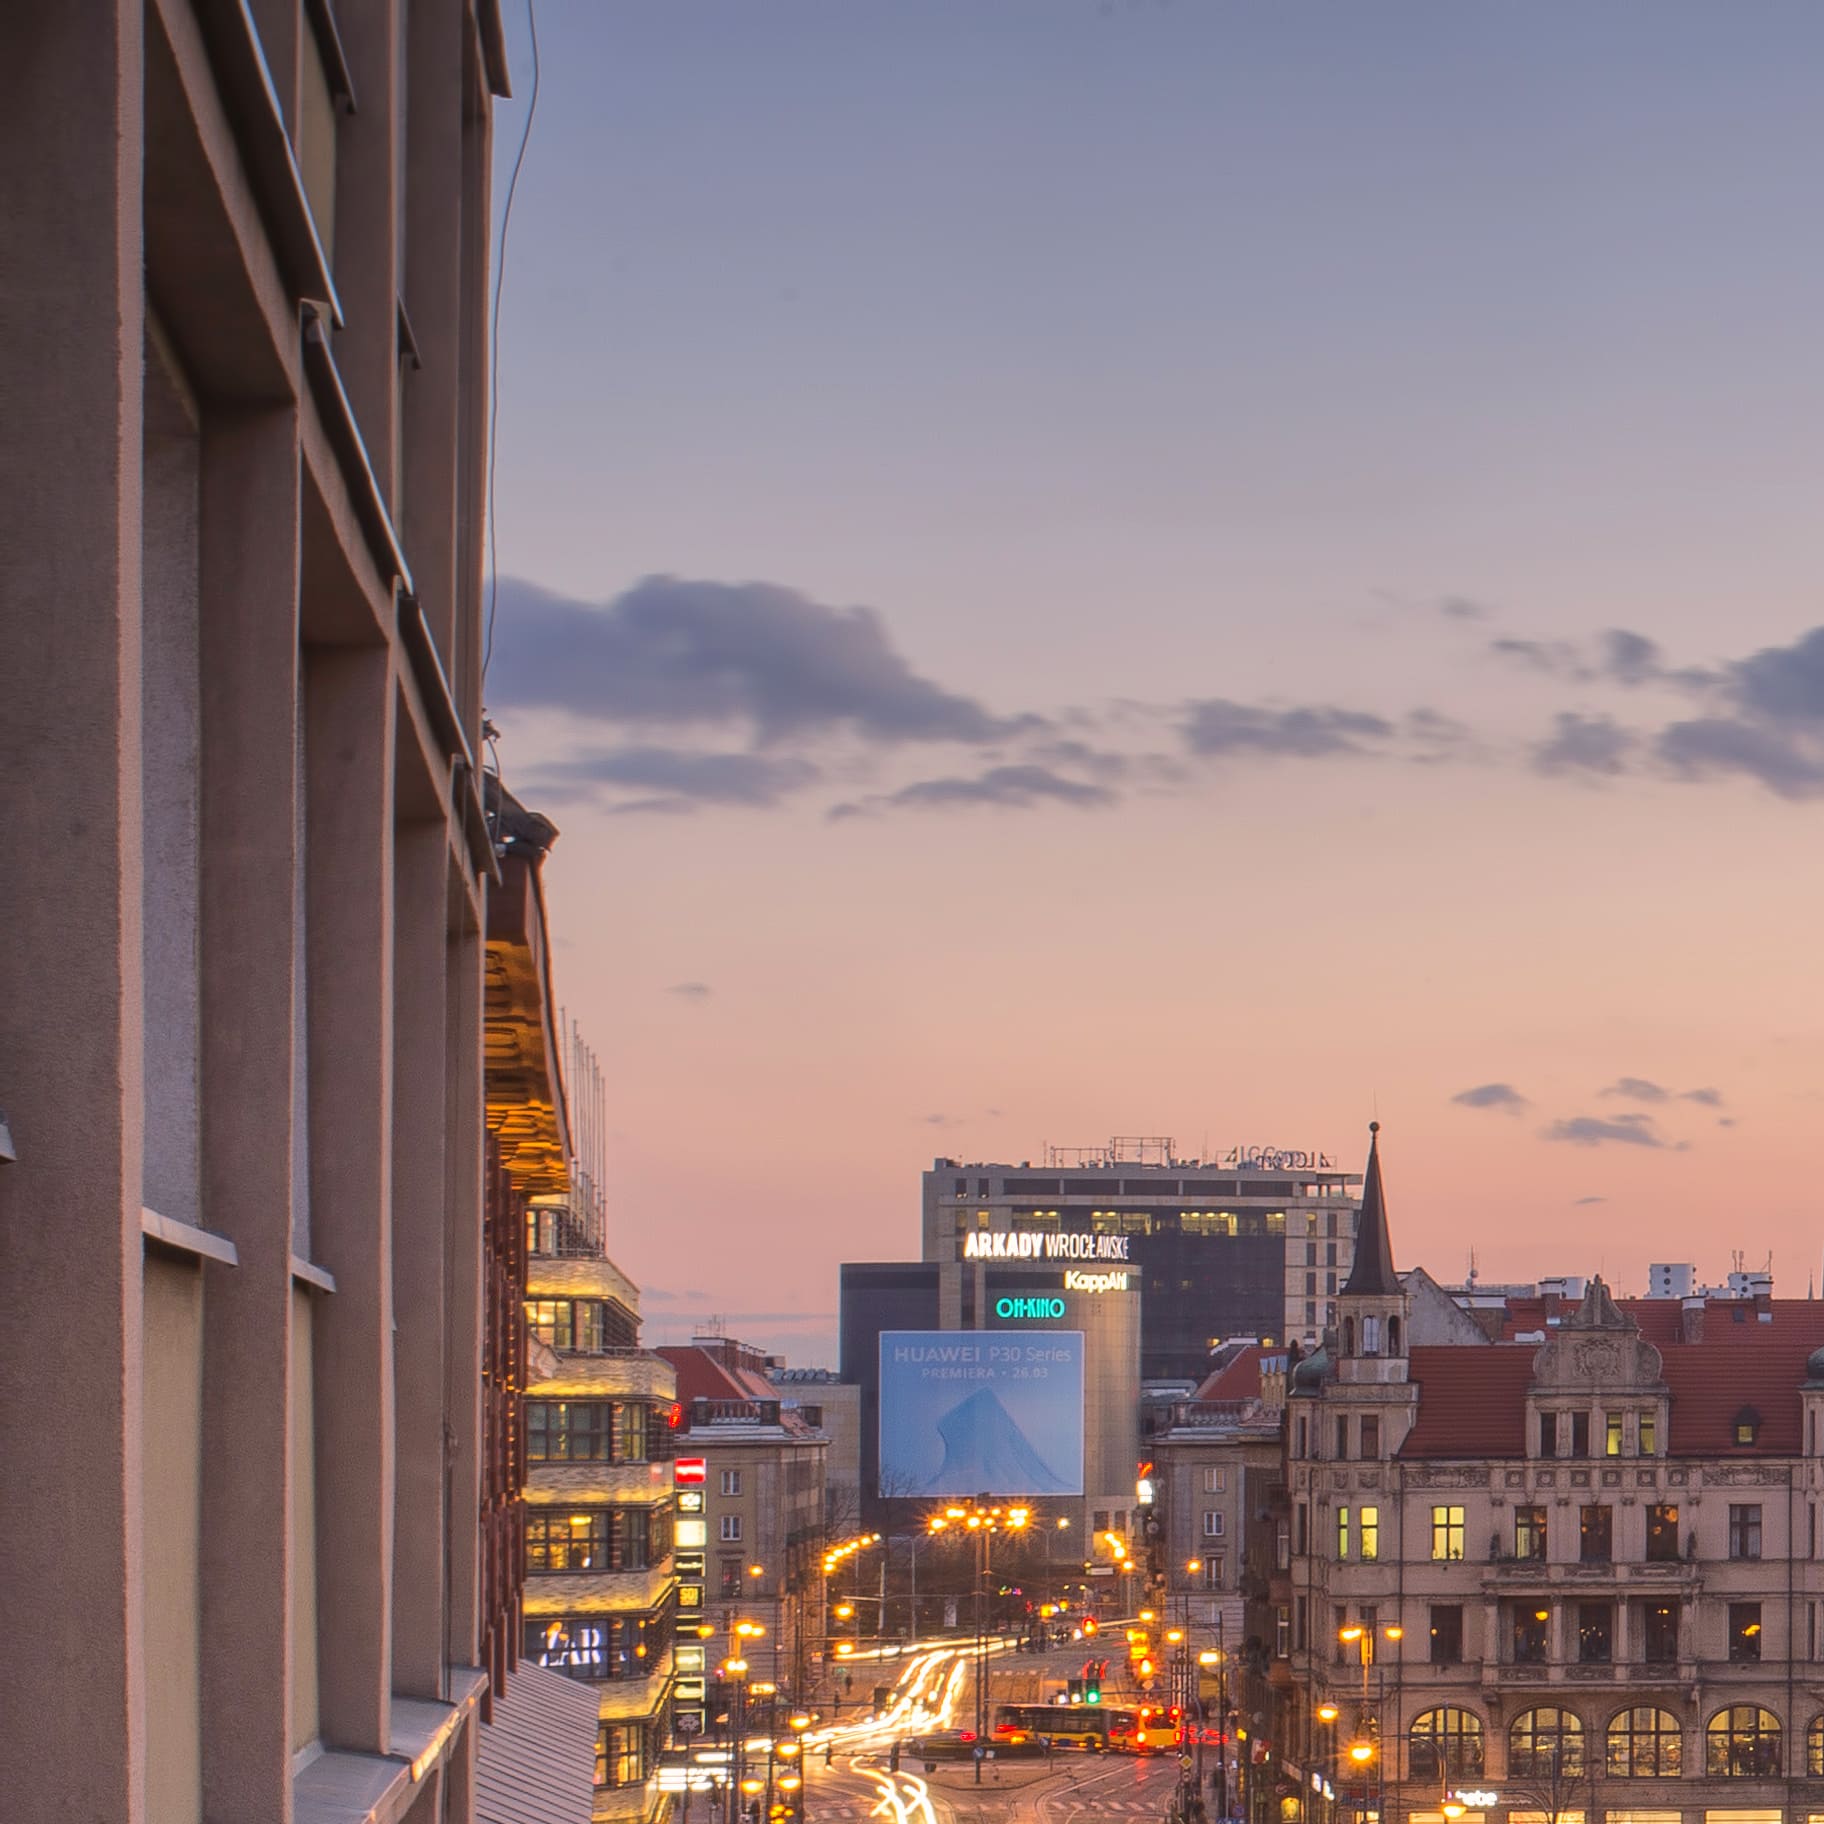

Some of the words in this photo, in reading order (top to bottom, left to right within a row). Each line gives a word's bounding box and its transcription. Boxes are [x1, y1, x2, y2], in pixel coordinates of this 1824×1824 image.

[964, 1232, 1044, 1258] ARKADY
[895, 1348, 980, 1362] HUAWEI
[990, 1347, 1020, 1362] P30
[1026, 1347, 1072, 1362] Series
[922, 1367, 995, 1379] PREMIERA
